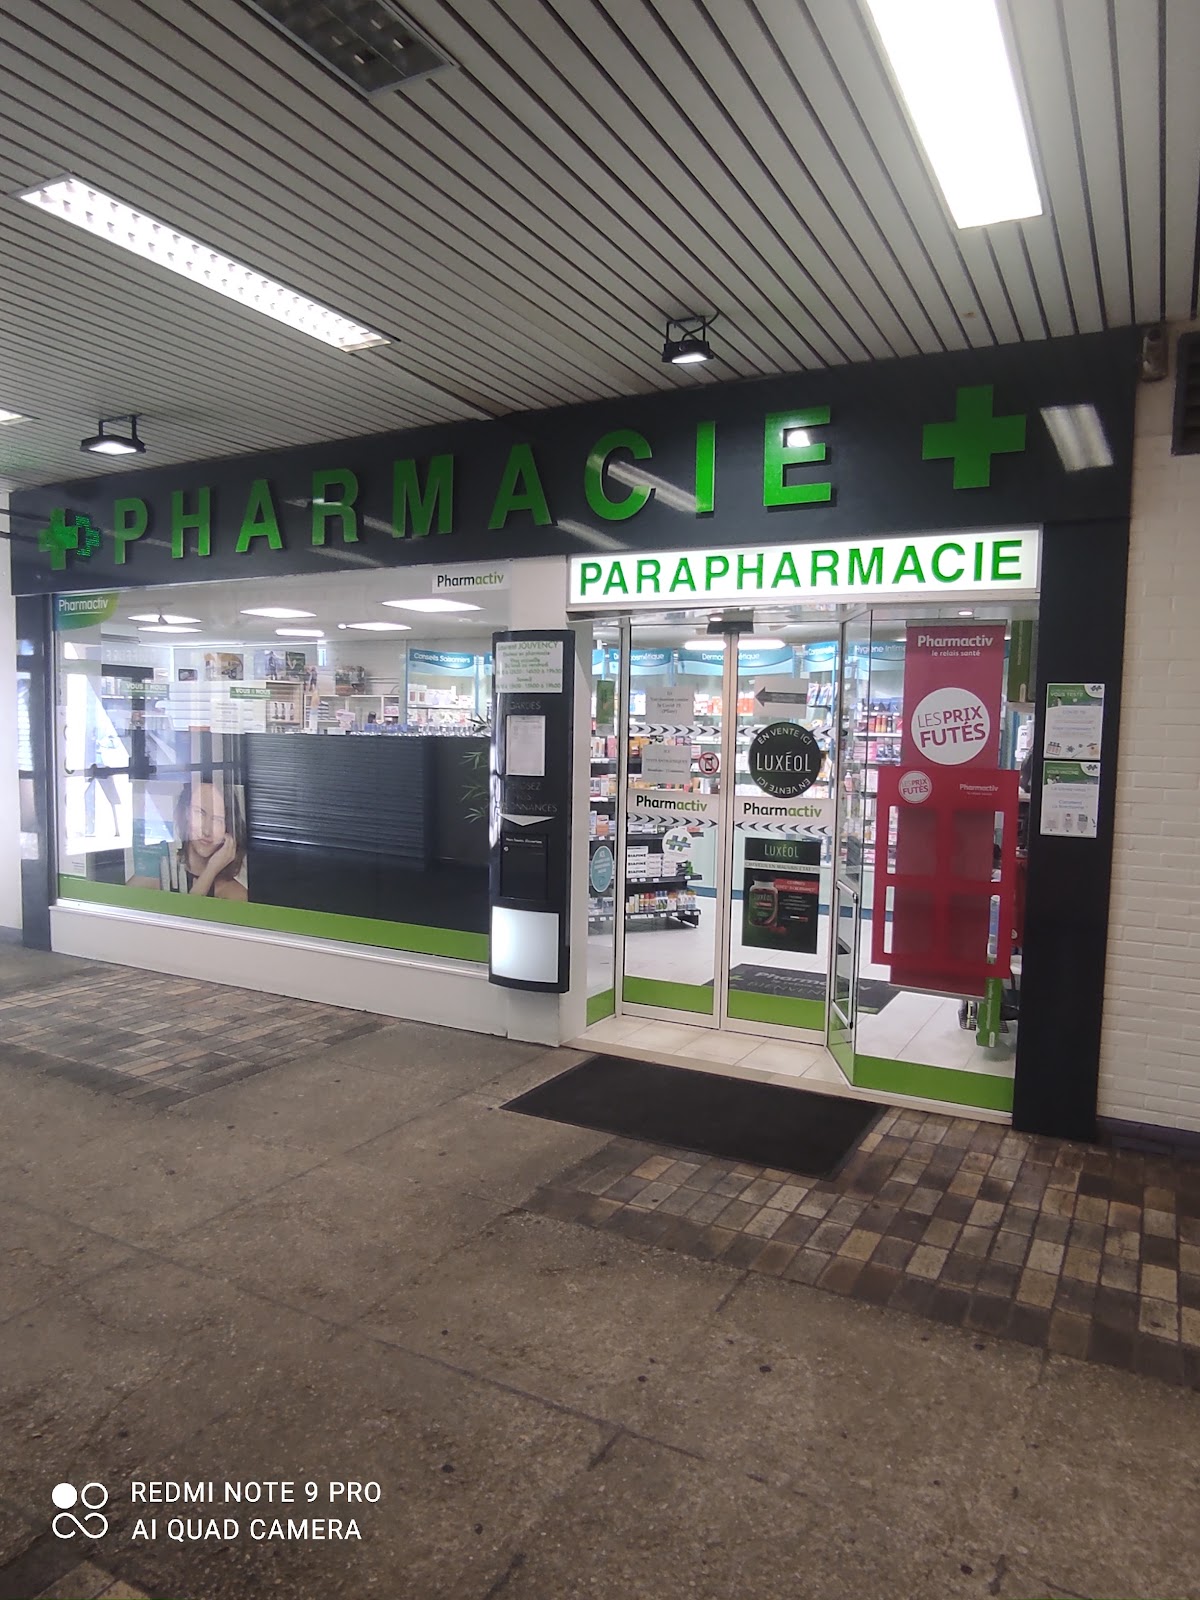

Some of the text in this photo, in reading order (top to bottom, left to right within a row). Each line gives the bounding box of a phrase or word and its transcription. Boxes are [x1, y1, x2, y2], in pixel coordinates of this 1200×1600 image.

[114, 405, 832, 565] PHARMACIE
[580, 539, 1024, 597] PARAPHARMACIE
[437, 571, 505, 588] Pharmactiv
[58, 597, 109, 612] Pharmactiv
[917, 634, 994, 648] Pharmactiv
[413, 652, 439, 661] Conseils
[917, 705, 983, 729] LES PRIX
[757, 727, 812, 746] EN VENTE ICI
[920, 720, 986, 749] FUTÉS
[756, 751, 812, 772] LUXÉOL
[756, 776, 811, 795] EN VENTE ICI
[911, 778, 928, 786] PRIX
[959, 783, 999, 792] Pharmactiv
[636, 794, 708, 812] Pharmactiv
[743, 802, 823, 818] Pharmactiv
[764, 842, 799, 858] LUXÉOL
